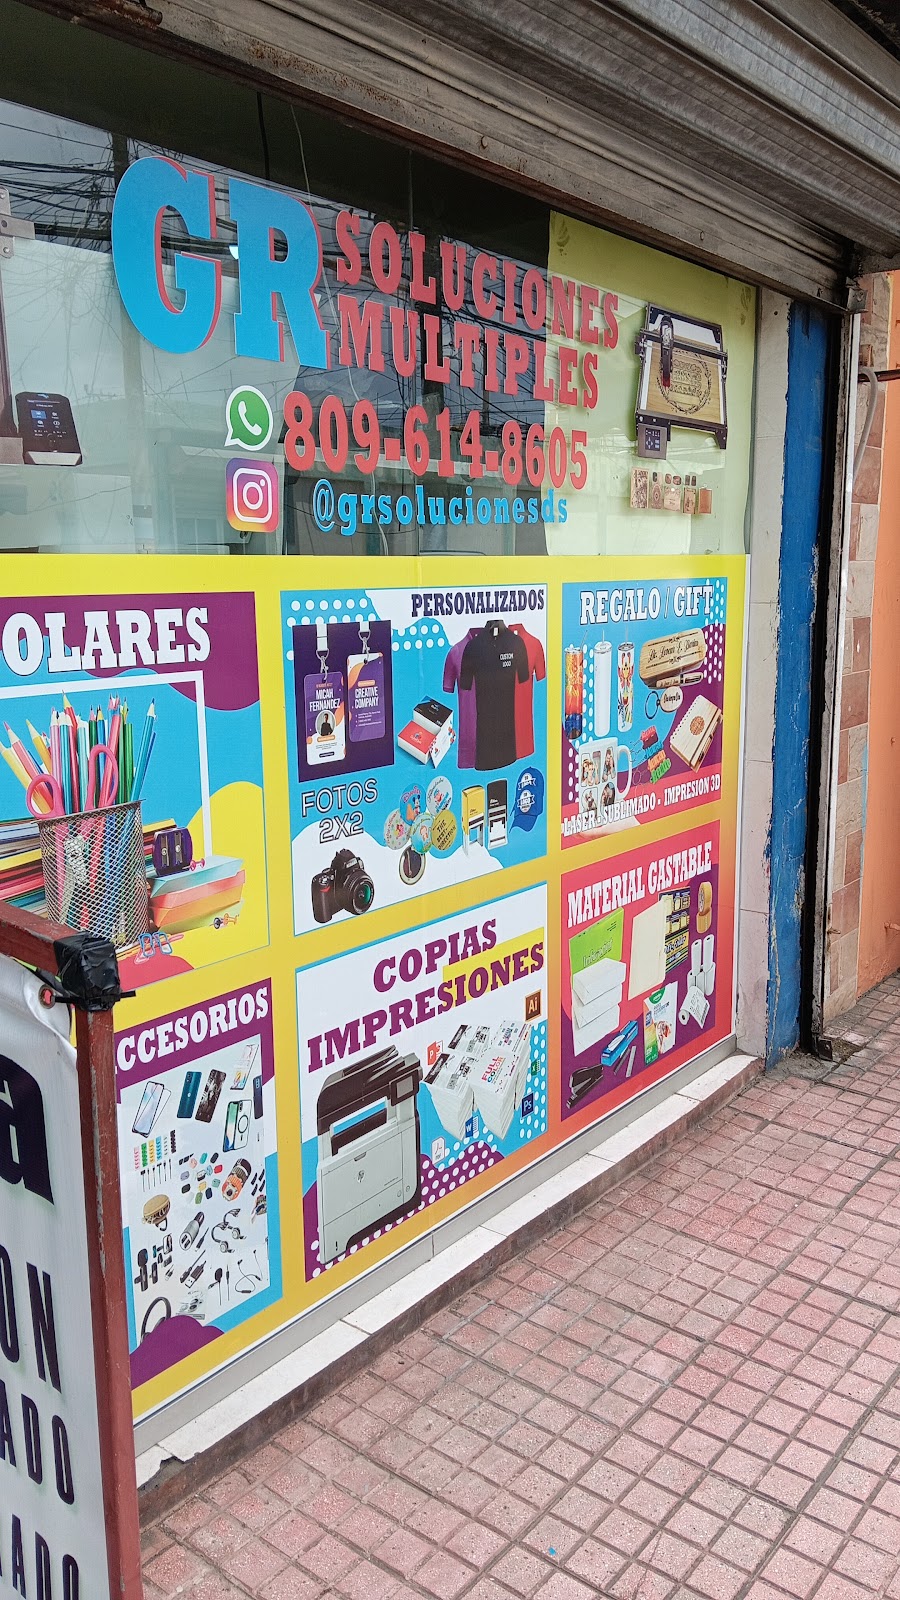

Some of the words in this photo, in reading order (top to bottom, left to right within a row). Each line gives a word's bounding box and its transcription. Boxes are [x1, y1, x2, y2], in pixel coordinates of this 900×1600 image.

[111, 155, 331, 370] GR
[335, 209, 619, 350] SOLUCIONES
[337, 293, 599, 410] MULTIPLES
[283, 391, 588, 490] 809-614-8605
[312, 478, 568, 537] @grsolucionesds
[411, 589, 545, 618] PERSONALIZADOS
[579, 587, 661, 625] REGALO
[673, 585, 714, 617] GIFT
[2, 607, 211, 676] OLARES
[500, 652, 514, 660] CUSTOM
[309, 698, 341, 712] FERNANDEZ
[315, 688, 334, 699] MICAH
[354, 686, 379, 698] CREATIVE
[354, 697, 379, 709] COMPANY
[301, 778, 378, 818] FOTOS
[563, 809, 596, 837] LASER
[602, 792, 656, 826] SUBLIMADO
[664, 779, 710, 807] IMPRESION
[710, 773, 721, 792] 3D
[318, 811, 364, 844] 2X2
[567, 866, 645, 928] MATERIAL
[647, 840, 712, 895] GASTABLE
[373, 918, 497, 993] COPIAS
[307, 941, 544, 1074] IMPRESIONES
[528, 997, 538, 1014] Ai
[115, 986, 269, 1074] CCESORIOS
[481, 1056, 499, 1081] FULL
[487, 1056, 504, 1083] COLOR
[523, 1100, 532, 1112] Ps
